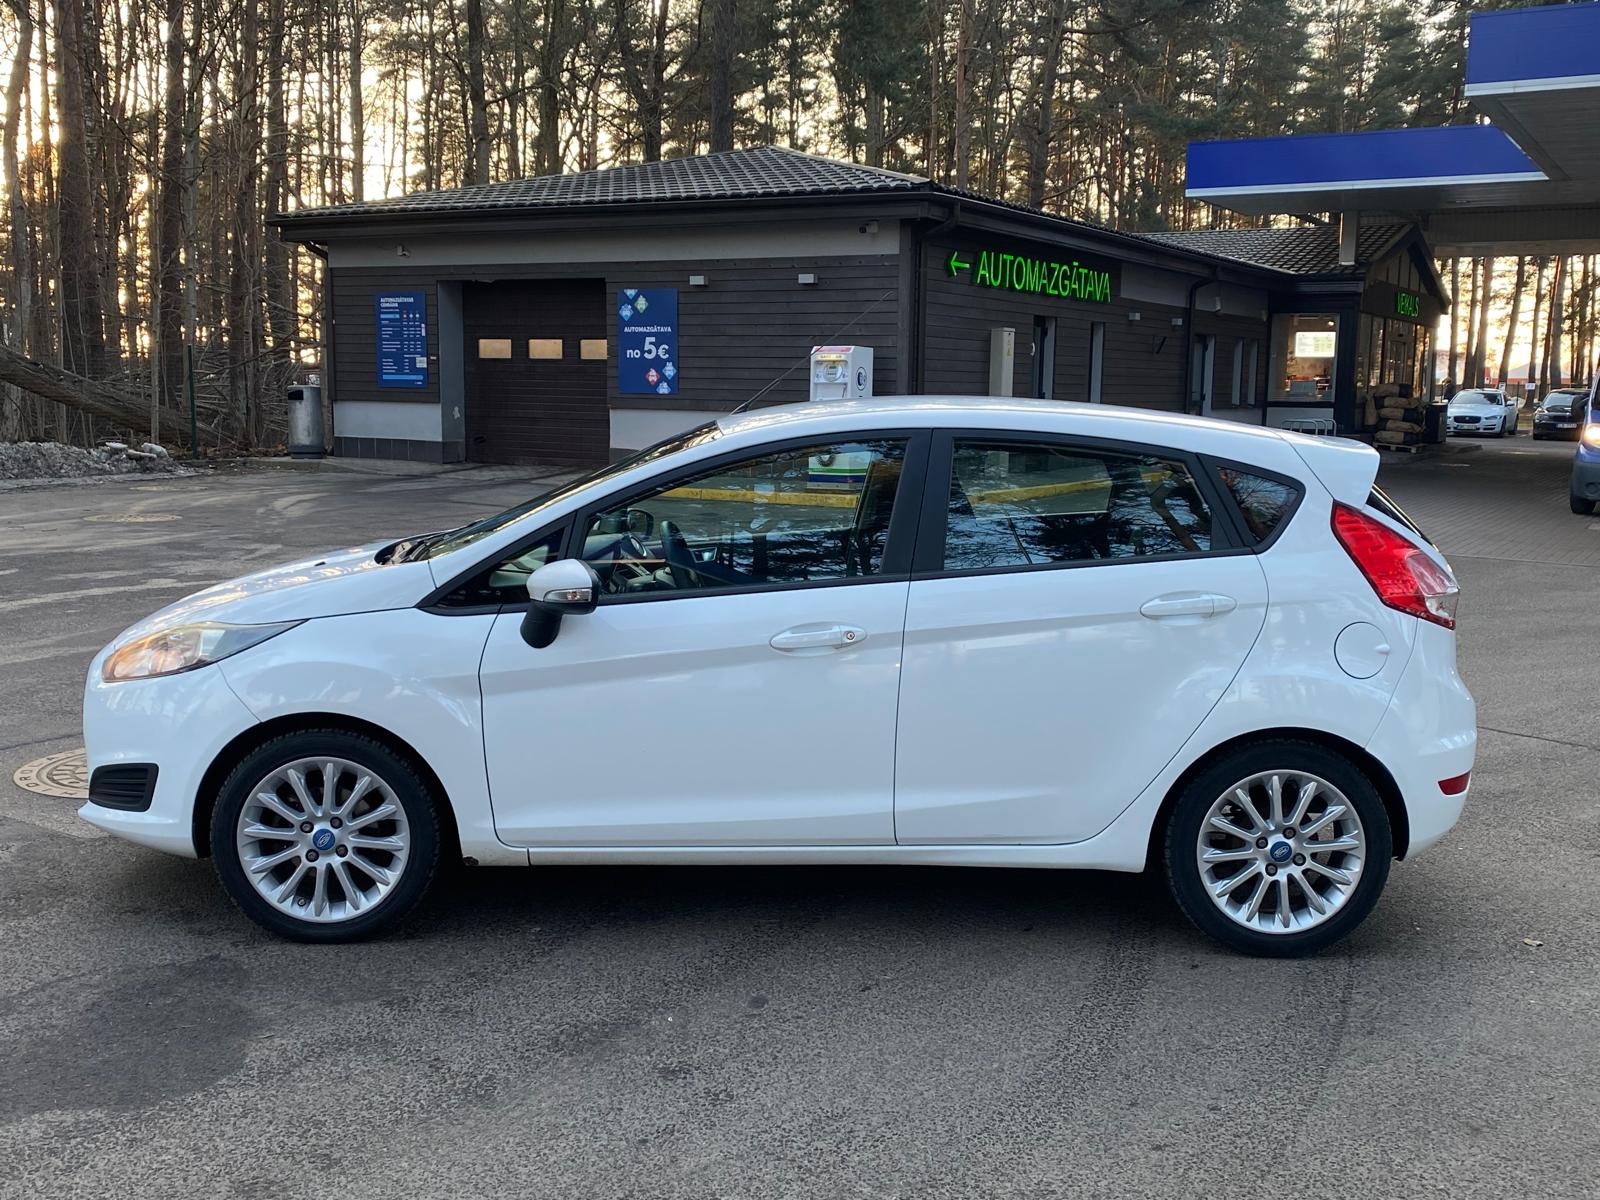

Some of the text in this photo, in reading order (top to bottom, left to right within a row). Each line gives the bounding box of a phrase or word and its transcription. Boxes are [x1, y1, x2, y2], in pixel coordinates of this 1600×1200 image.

[976, 250, 1111, 302] AUTOMAZGĀTAVA
[623, 325, 672, 333] AUTOMAZGĀTAVA
[626, 336, 669, 359] no 5€
